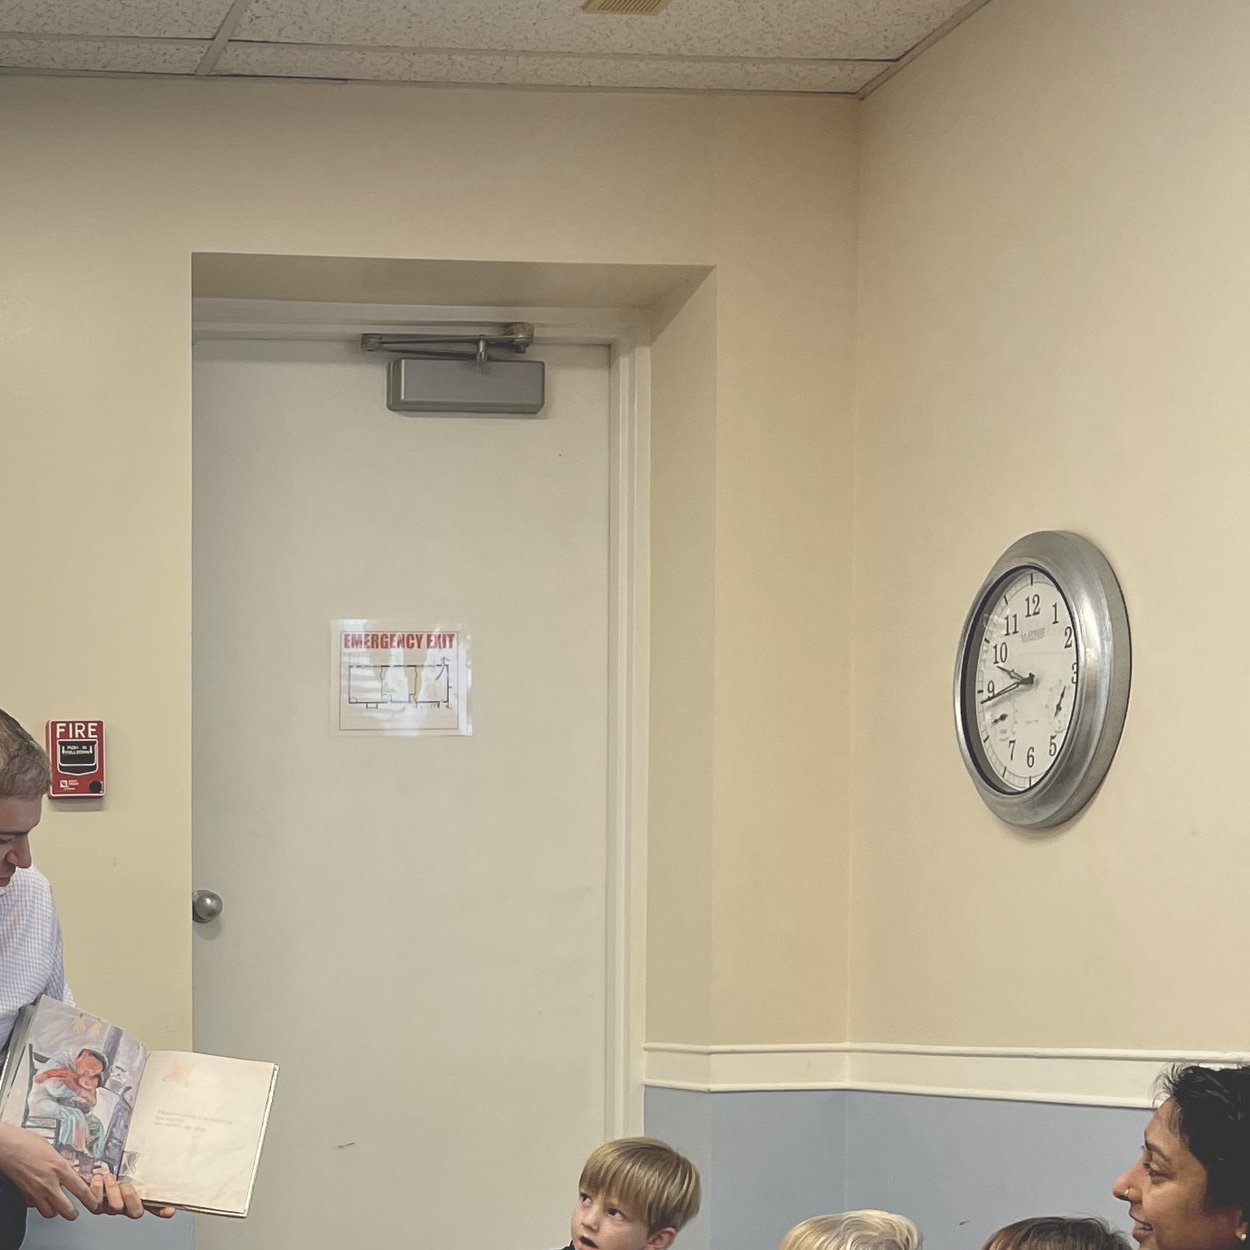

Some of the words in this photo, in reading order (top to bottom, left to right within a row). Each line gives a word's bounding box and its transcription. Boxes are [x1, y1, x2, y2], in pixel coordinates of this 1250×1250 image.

[1025, 594, 1041, 618] 12
[1052, 602, 1059, 624] 1
[1004, 613, 1019, 636] 11
[344, 633, 423, 649] EMERGENCY
[426, 633, 455, 649] EXIT
[1064, 626, 1073, 648] 2
[993, 642, 1008, 664] 10
[1071, 662, 1078, 685] 3
[987, 680, 996, 699] 9
[56, 723, 98, 738] FIRE
[1008, 740, 1016, 761] 7
[1049, 735, 1057, 756] 5
[1026, 746, 1035, 768] 6
